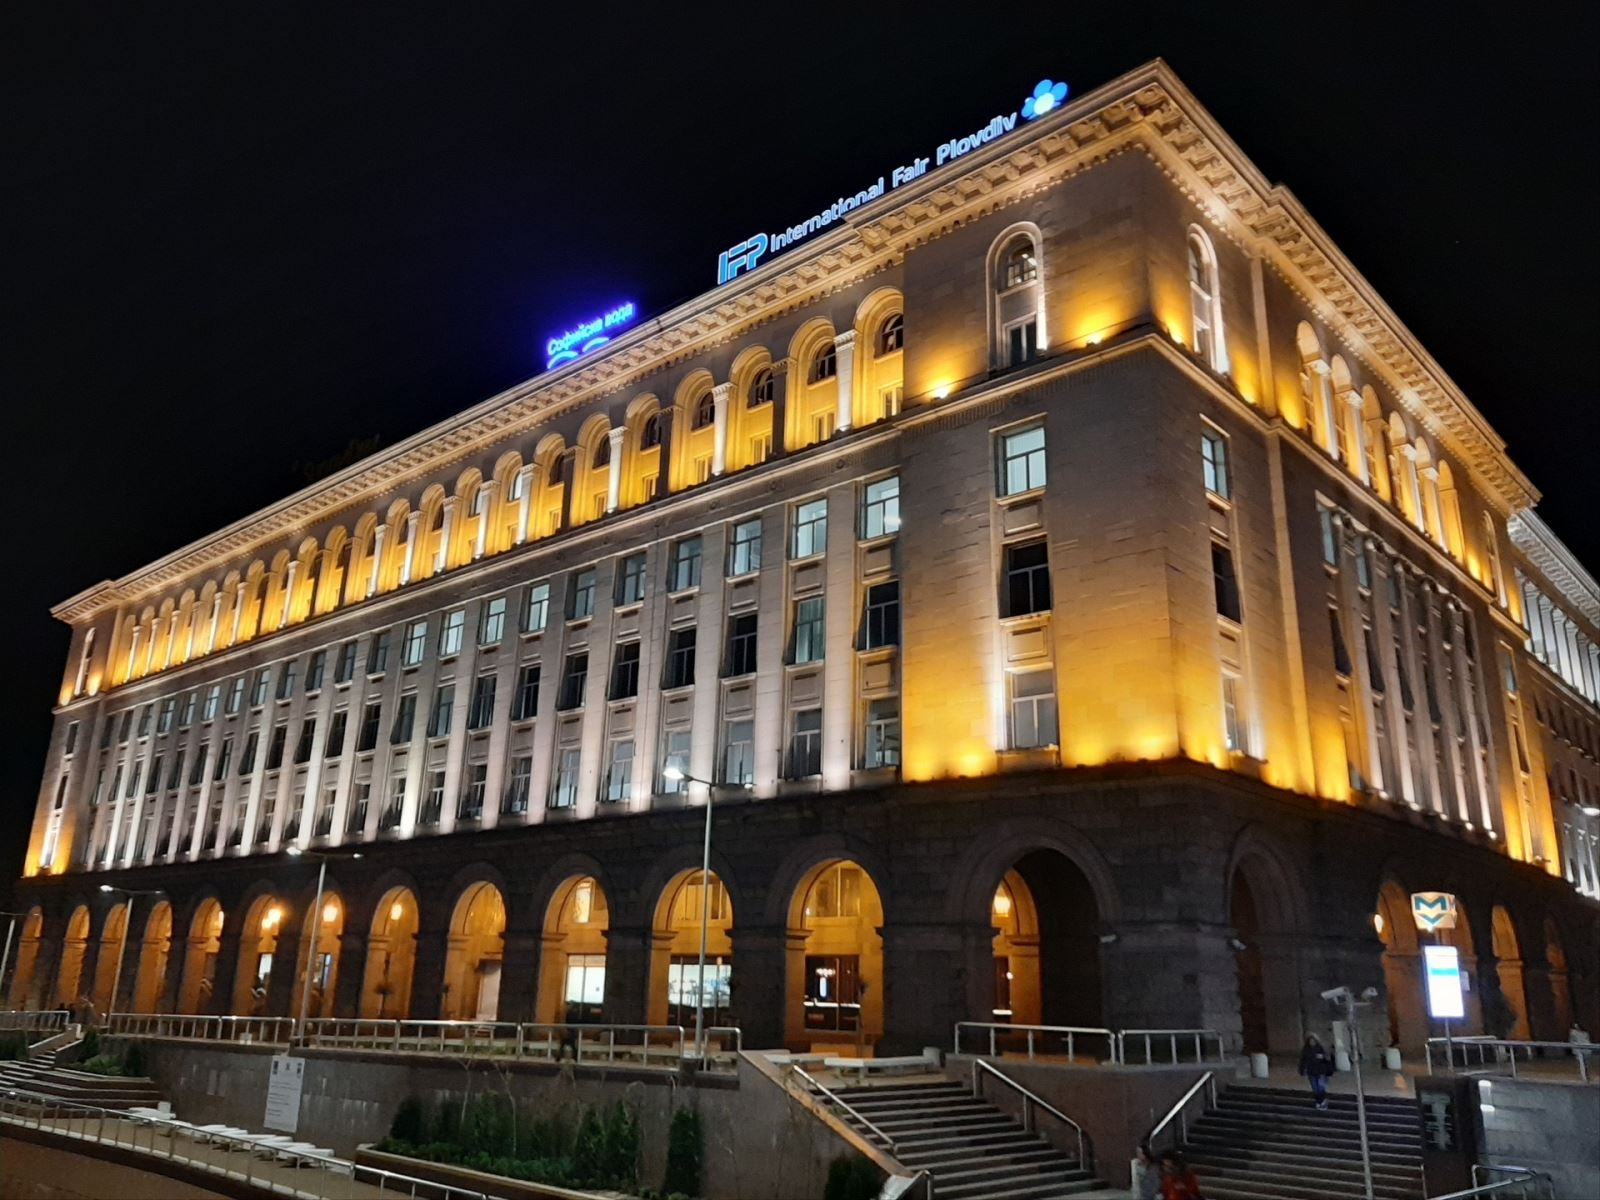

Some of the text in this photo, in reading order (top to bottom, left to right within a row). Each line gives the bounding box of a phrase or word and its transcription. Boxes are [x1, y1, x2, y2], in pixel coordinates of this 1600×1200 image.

[717, 111, 1017, 285] IFP International Fair Plovdiv
